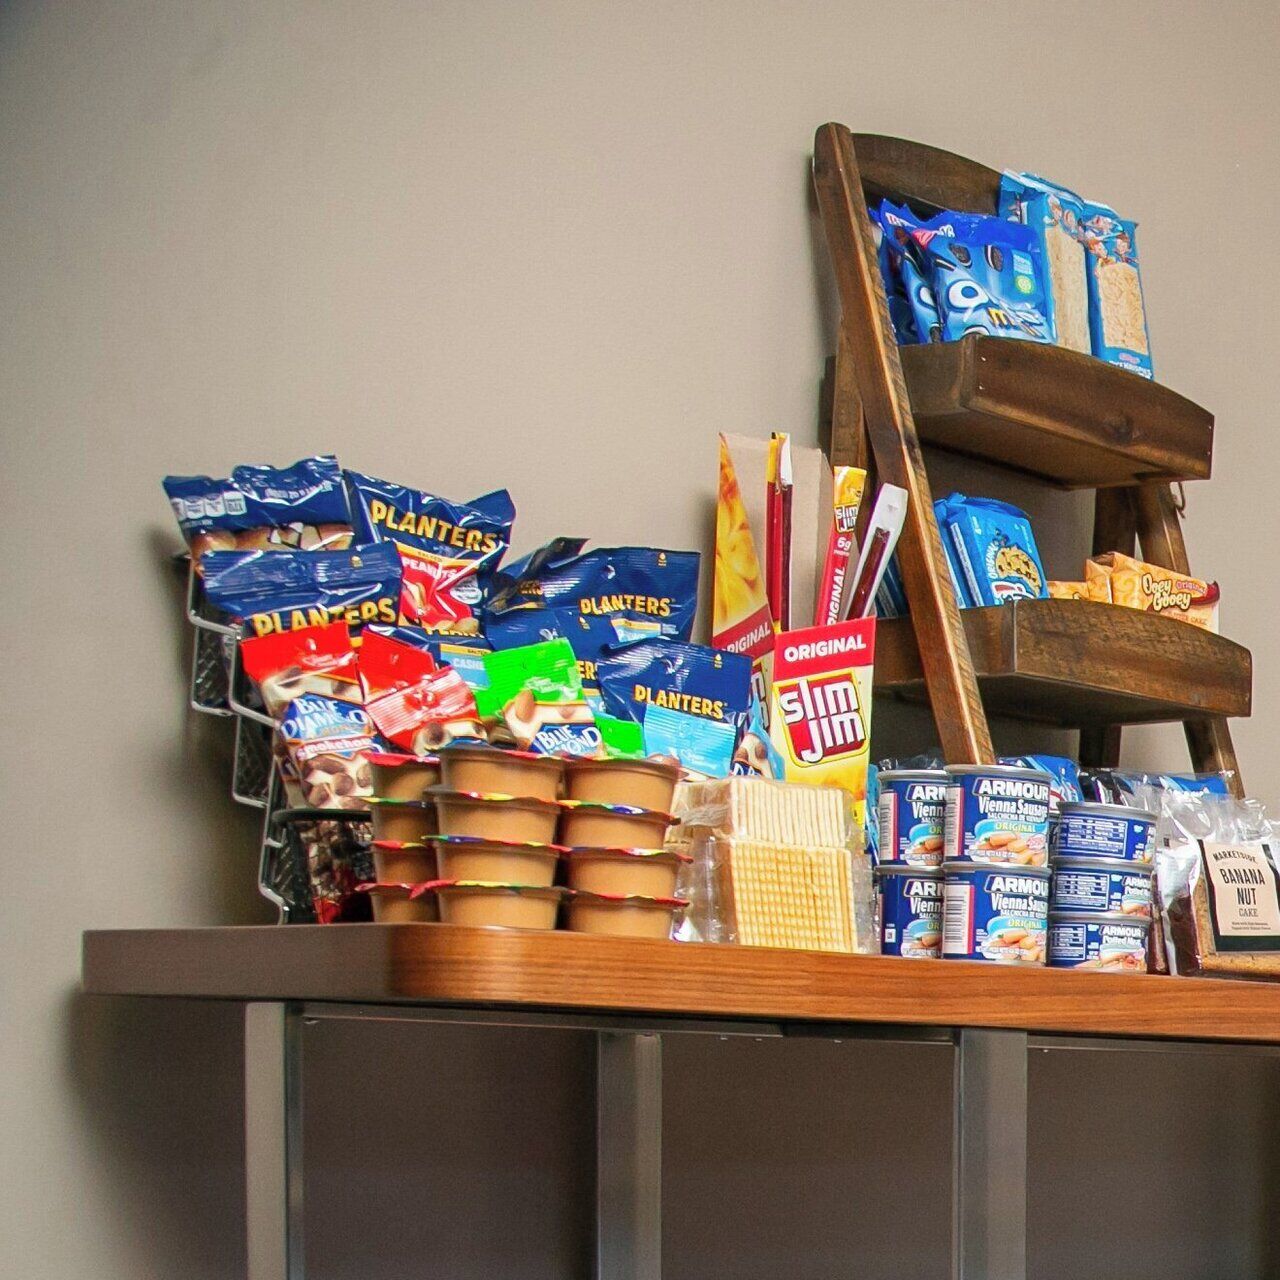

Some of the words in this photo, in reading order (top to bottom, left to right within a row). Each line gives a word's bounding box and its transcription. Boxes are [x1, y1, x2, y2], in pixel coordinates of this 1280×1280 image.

[370, 499, 498, 554] PLANTERS
[1142, 573, 1172, 596] Ooey
[579, 595, 672, 617] PLANTERS
[827, 566, 845, 626] RIGINAL
[1152, 591, 1191, 612] Gooey
[721, 624, 771, 653] RIGINAL
[784, 633, 867, 663] ORIGINAL
[634, 684, 725, 720] PLANTERS
[536, 725, 577, 750] BLUE
[979, 780, 1049, 800] ARMOUR
[979, 796, 1016, 814] Vienna
[1213, 850, 1258, 864] MARKETSIDE
[991, 876, 1049, 897] ARMOU
[1220, 868, 1266, 885] BANANA
[991, 893, 1027, 911] Vienna
[1237, 888, 1257, 905] NUT
[1239, 908, 1259, 917] CAKE
